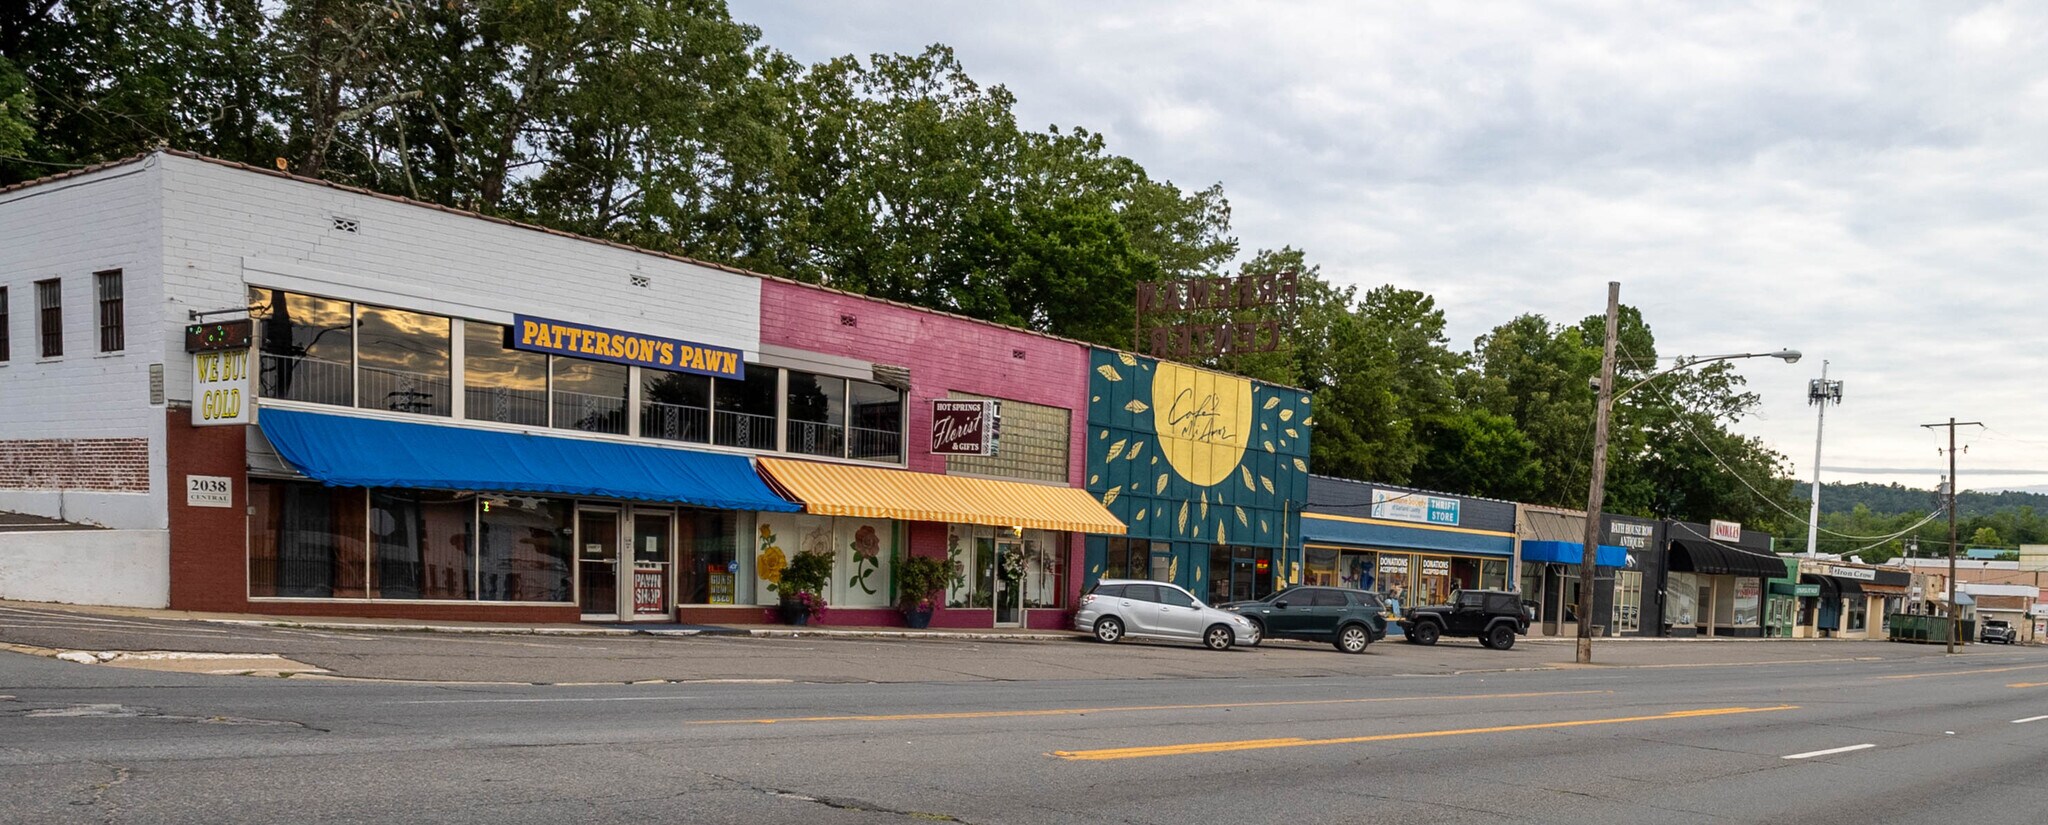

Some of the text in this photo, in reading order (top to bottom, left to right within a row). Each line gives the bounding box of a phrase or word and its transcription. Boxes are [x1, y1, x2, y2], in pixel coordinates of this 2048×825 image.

[523, 320, 738, 374] PATTERSON'S PAWN
[197, 350, 248, 383] WE BUY
[202, 388, 241, 420] GOLD
[937, 403, 982, 412] HOT SPRINGS
[934, 411, 982, 449] Florist
[959, 443, 979, 451] GIFTS
[190, 479, 227, 493] 2038
[190, 494, 228, 502] CENTRAL
[1431, 500, 1456, 511] THRIFT
[1432, 512, 1454, 521] STORE
[1611, 522, 1625, 534] BATH
[1625, 524, 1642, 536] HOUSE
[1619, 536, 1645, 549] ANTIQUES
[1380, 557, 1408, 567] DONATIONS
[1423, 559, 1449, 569] DONATIONS
[1836, 569, 1853, 577] Iron
[635, 574, 661, 588] PAWN
[635, 588, 661, 604] SHOP
